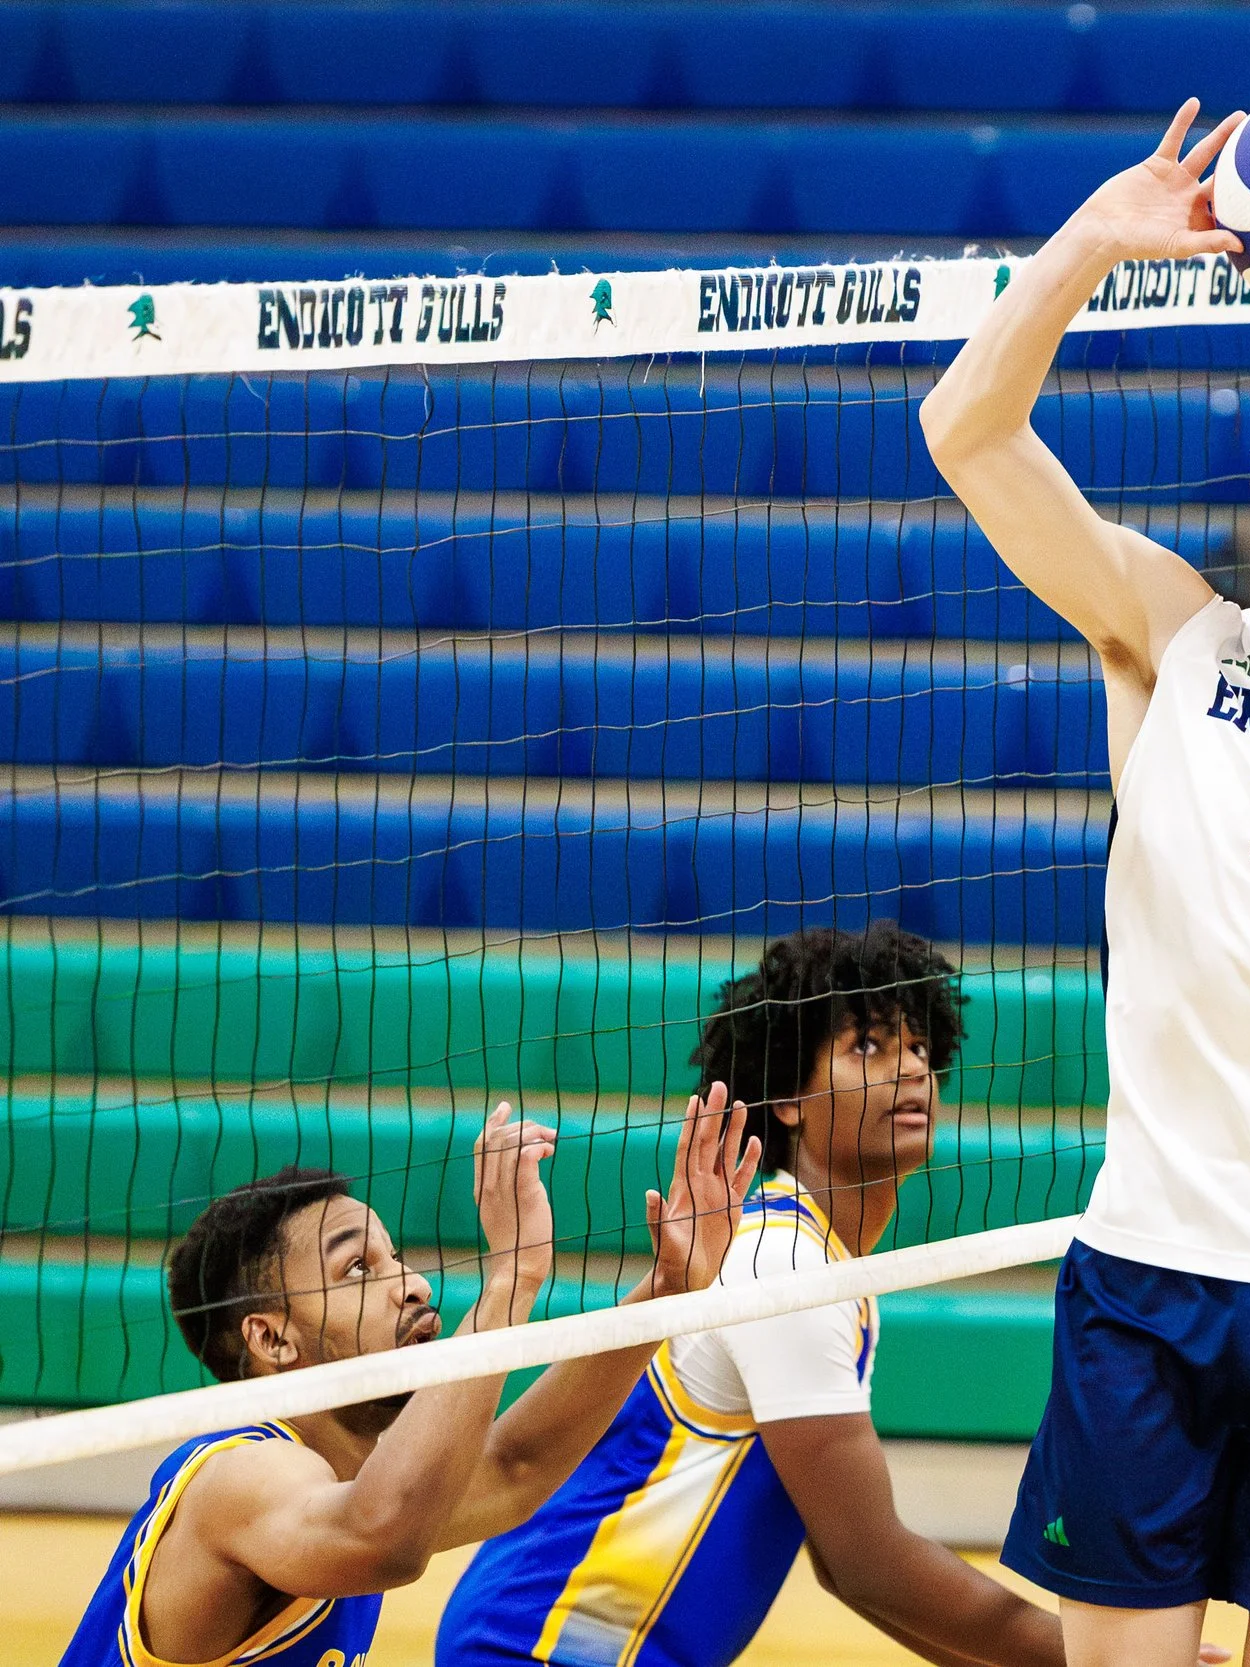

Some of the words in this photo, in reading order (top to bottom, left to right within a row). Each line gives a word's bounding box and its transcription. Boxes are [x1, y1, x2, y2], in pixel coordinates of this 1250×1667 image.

[257, 285, 408, 349] ENDICOTT
[415, 282, 506, 343] GULLS
[697, 269, 836, 333] ENDICOTT
[836, 266, 921, 324] GULLS
